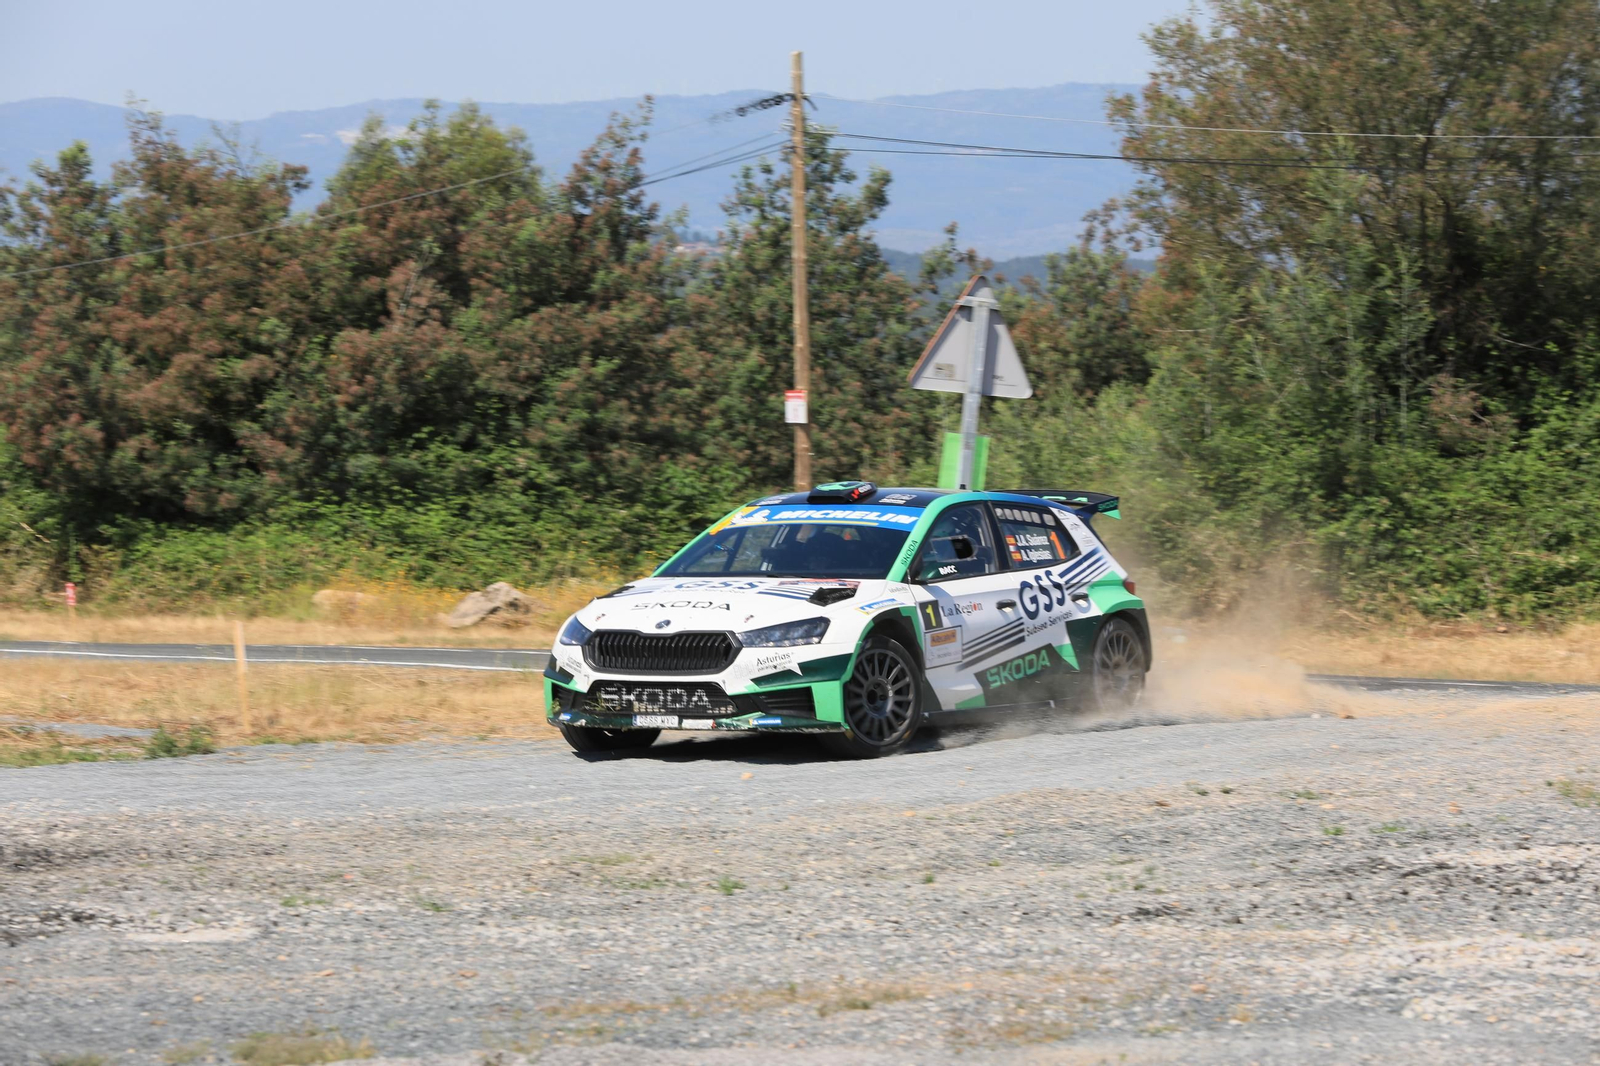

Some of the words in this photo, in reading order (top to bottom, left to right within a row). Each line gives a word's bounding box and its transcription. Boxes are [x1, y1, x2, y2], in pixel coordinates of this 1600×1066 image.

[772, 509, 919, 524] MICHELIN
[1049, 531, 1066, 560] 1
[1018, 570, 1066, 620] GSS
[925, 604, 936, 627] 1
[940, 606, 954, 617] La
[757, 652, 791, 666] Asturias
